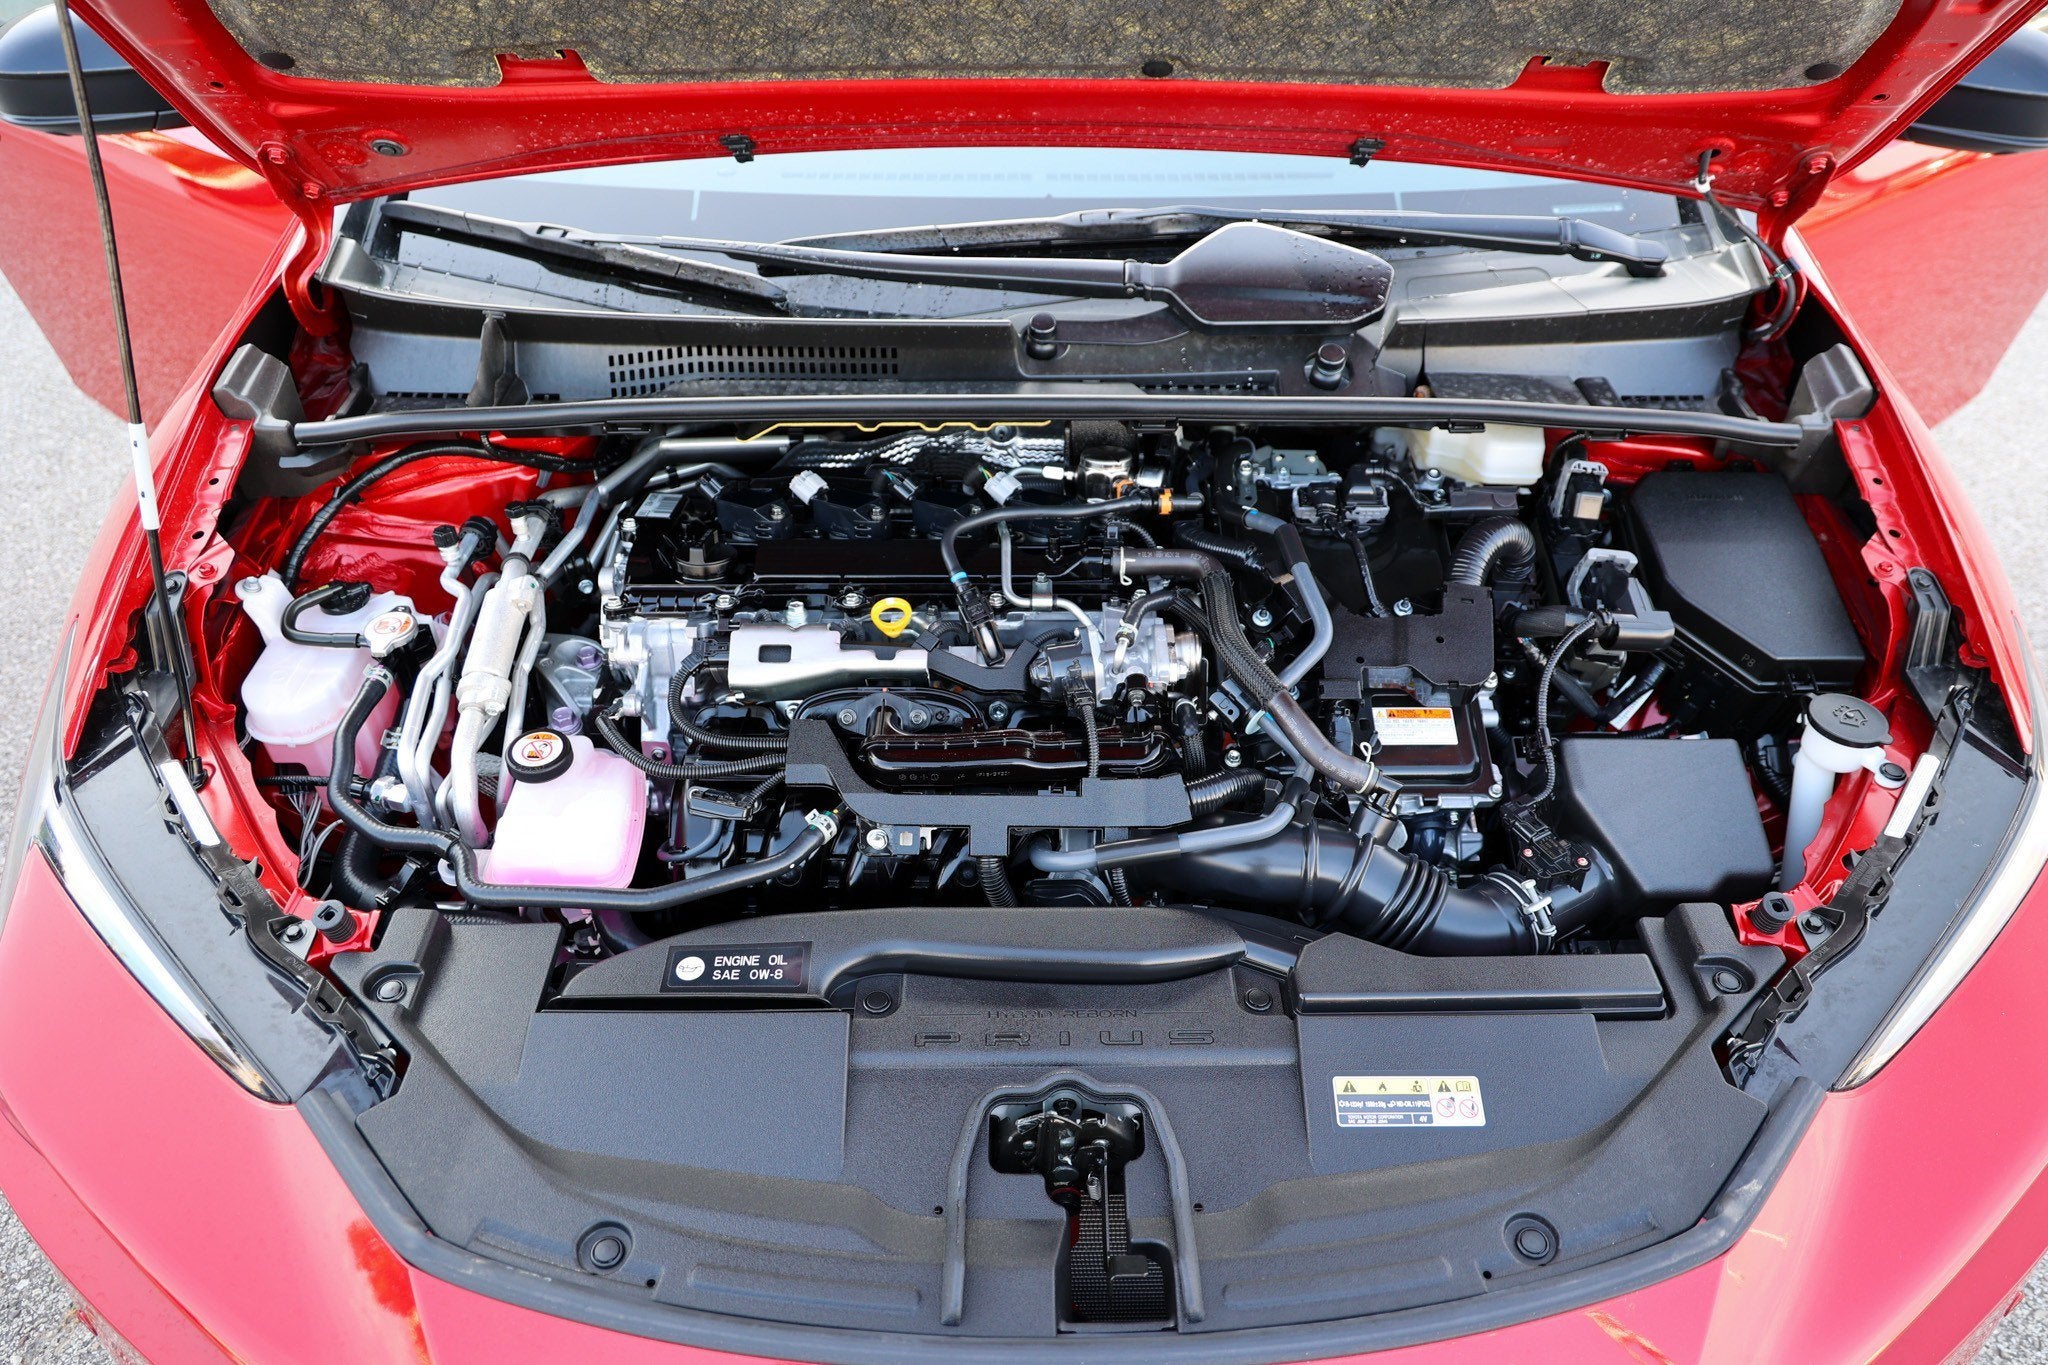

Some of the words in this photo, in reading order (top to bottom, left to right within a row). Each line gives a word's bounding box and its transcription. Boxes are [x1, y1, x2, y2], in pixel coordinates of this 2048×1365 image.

[714, 955, 760, 967] ENGINE
[768, 954, 788, 966] OIL
[712, 969, 740, 980] SAE
[749, 969, 783, 980] 0W-8
[987, 1009, 1053, 1019] HYBRID
[1063, 1009, 1138, 1019] REBORN
[914, 1029, 1215, 1047] PRIUS
